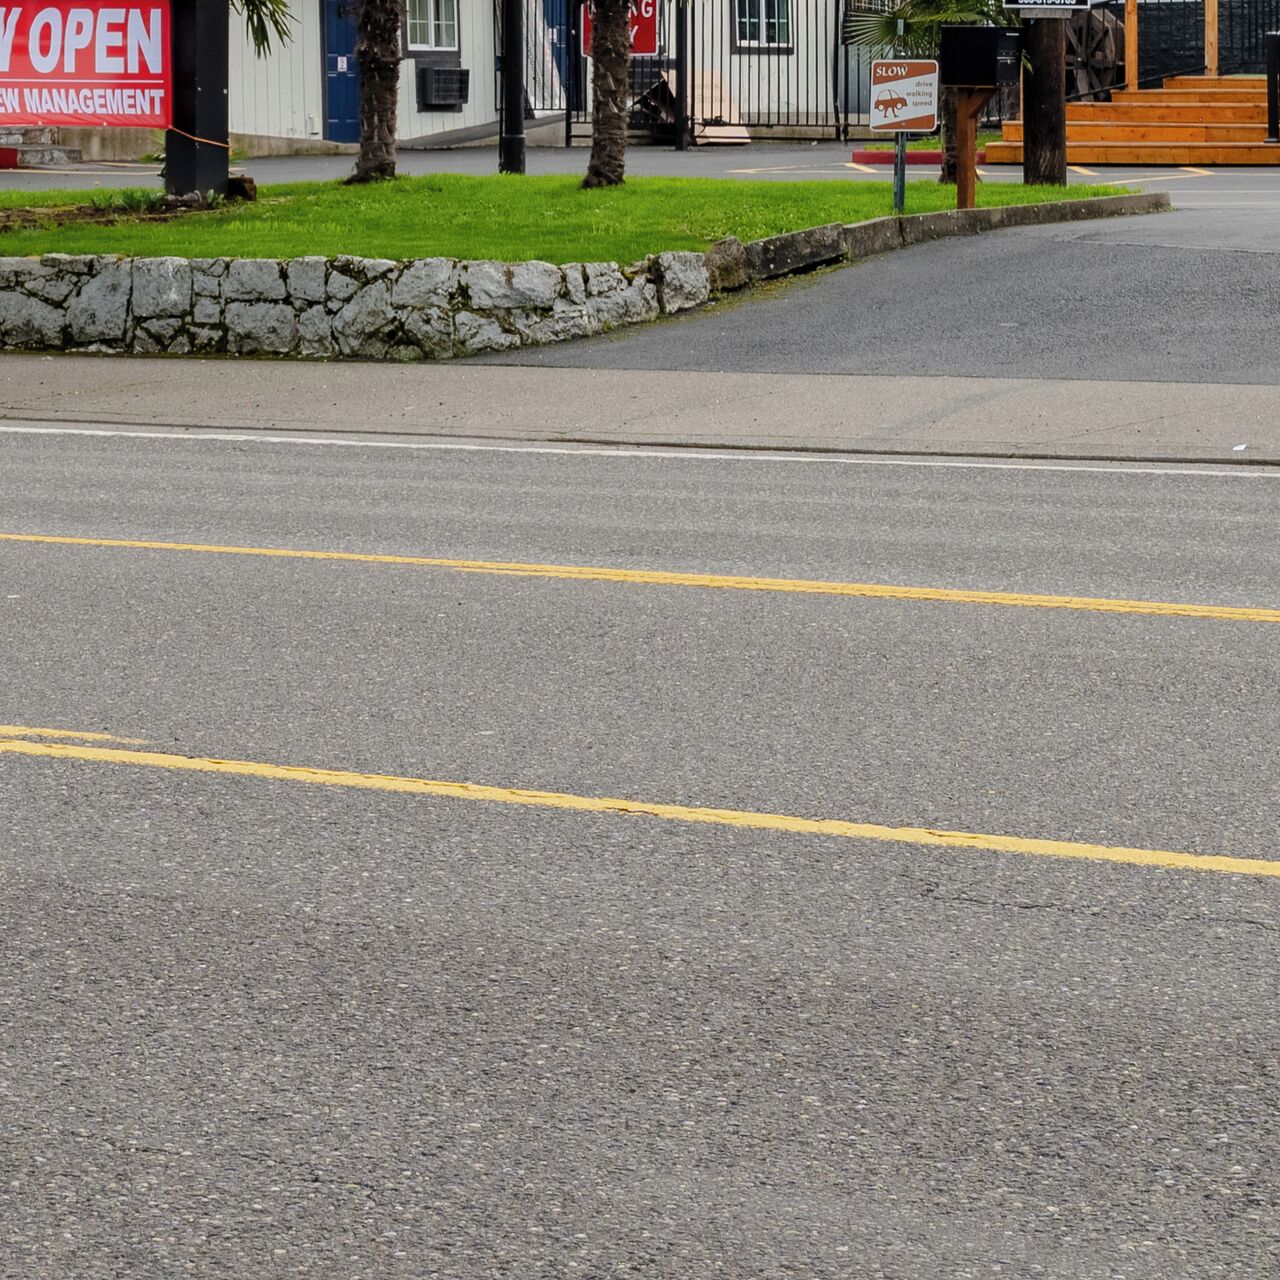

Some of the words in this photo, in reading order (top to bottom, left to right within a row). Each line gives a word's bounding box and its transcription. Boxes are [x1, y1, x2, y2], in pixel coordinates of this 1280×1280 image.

[28, 7, 162, 74] OPEN
[876, 64, 908, 77] SLOW
[24, 88, 165, 115] MANAGEMENT
[906, 90, 933, 98] walking
